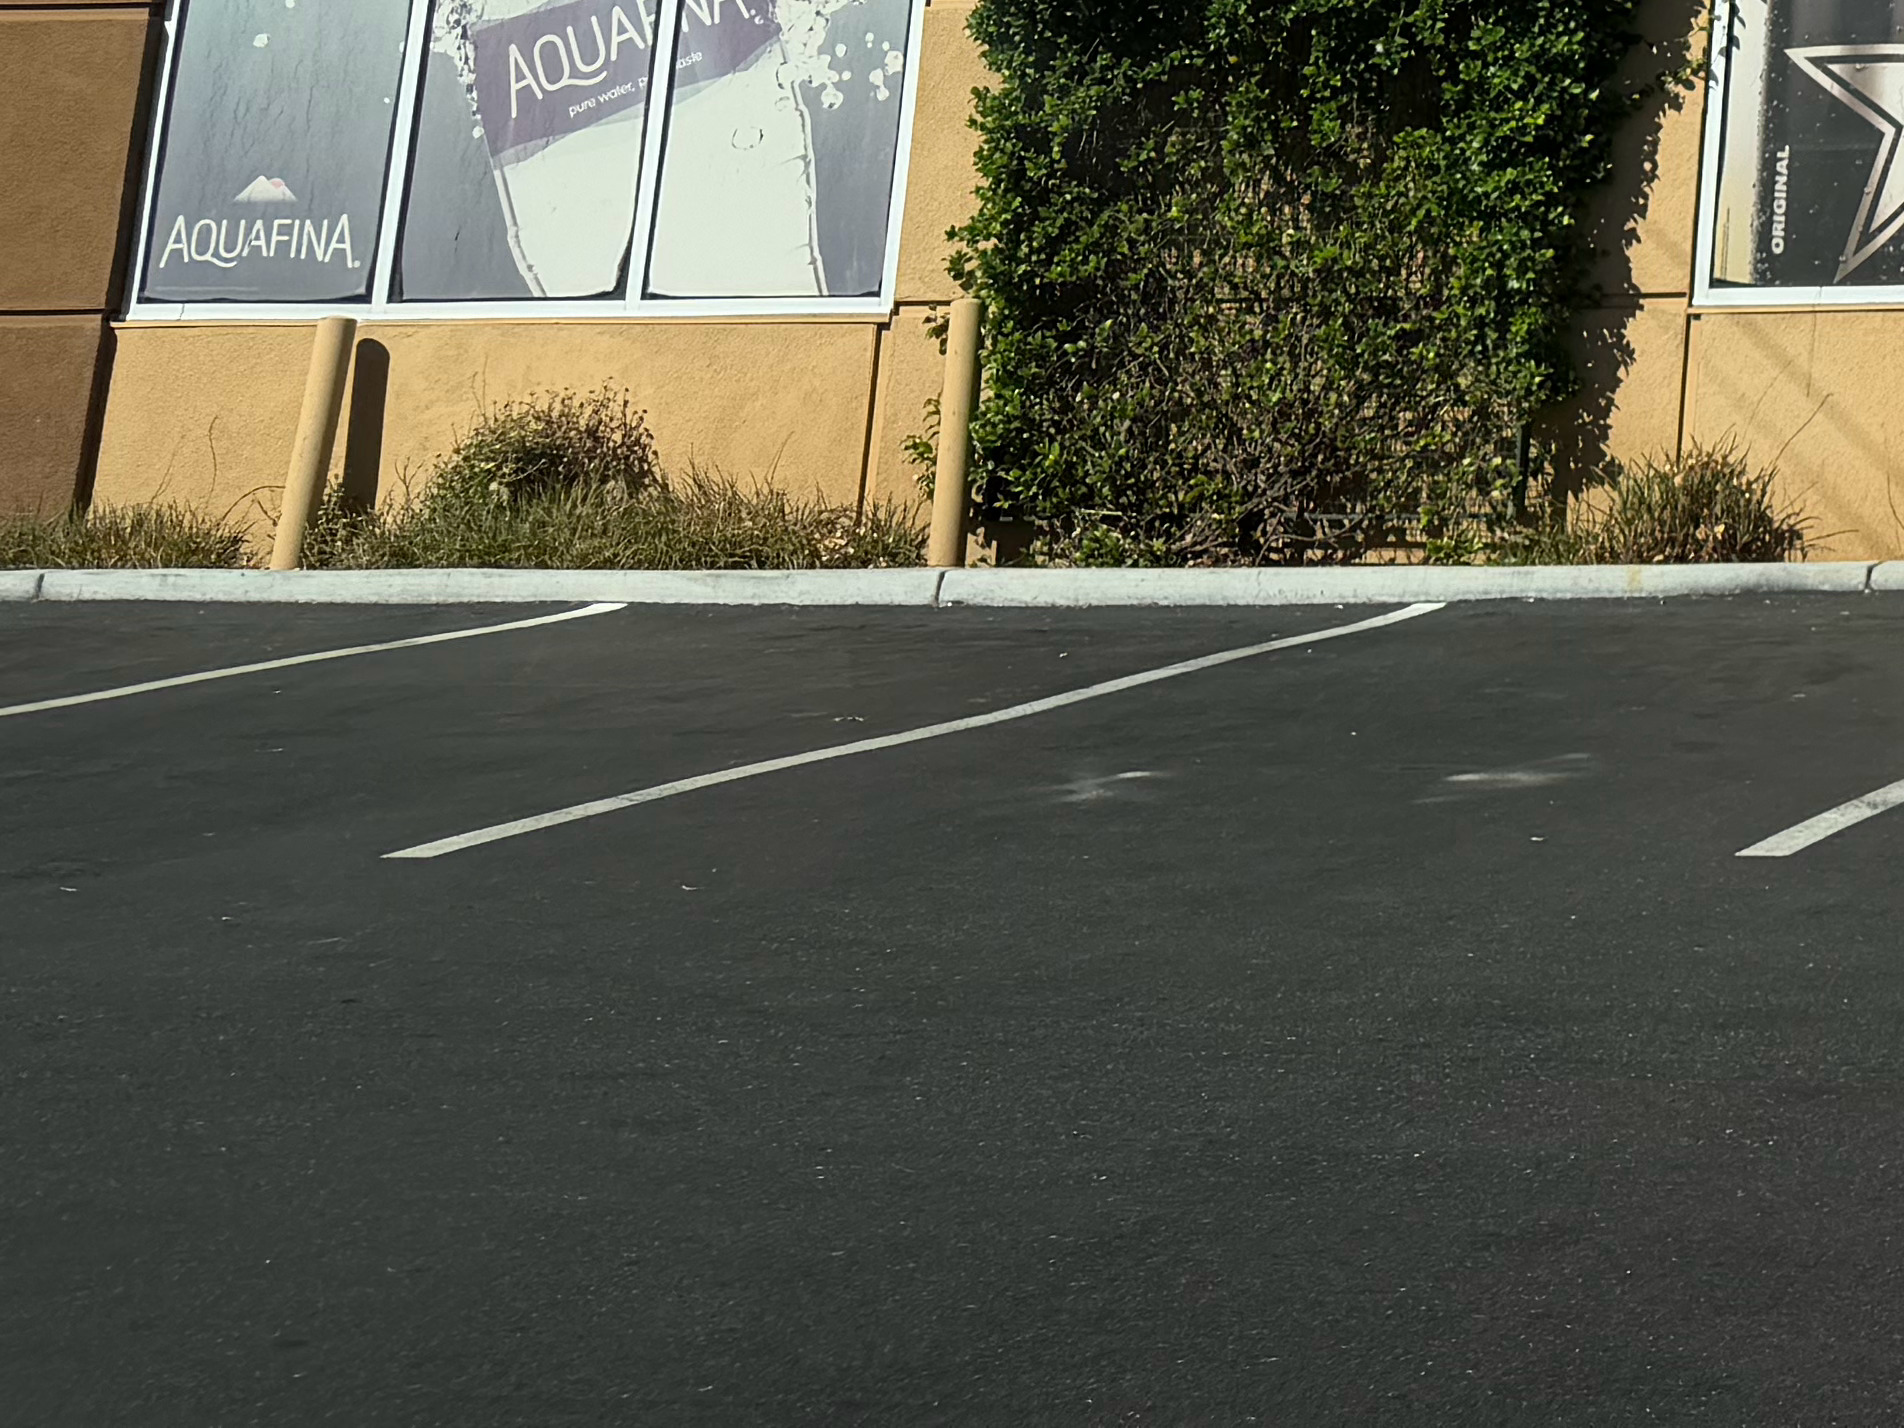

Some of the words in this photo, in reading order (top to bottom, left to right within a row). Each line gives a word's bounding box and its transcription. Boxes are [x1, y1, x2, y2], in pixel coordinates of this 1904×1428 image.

[568, 96, 596, 119] pure
[1771, 145, 1790, 255] ORIGINAL
[159, 213, 354, 269] AQUAFINA
